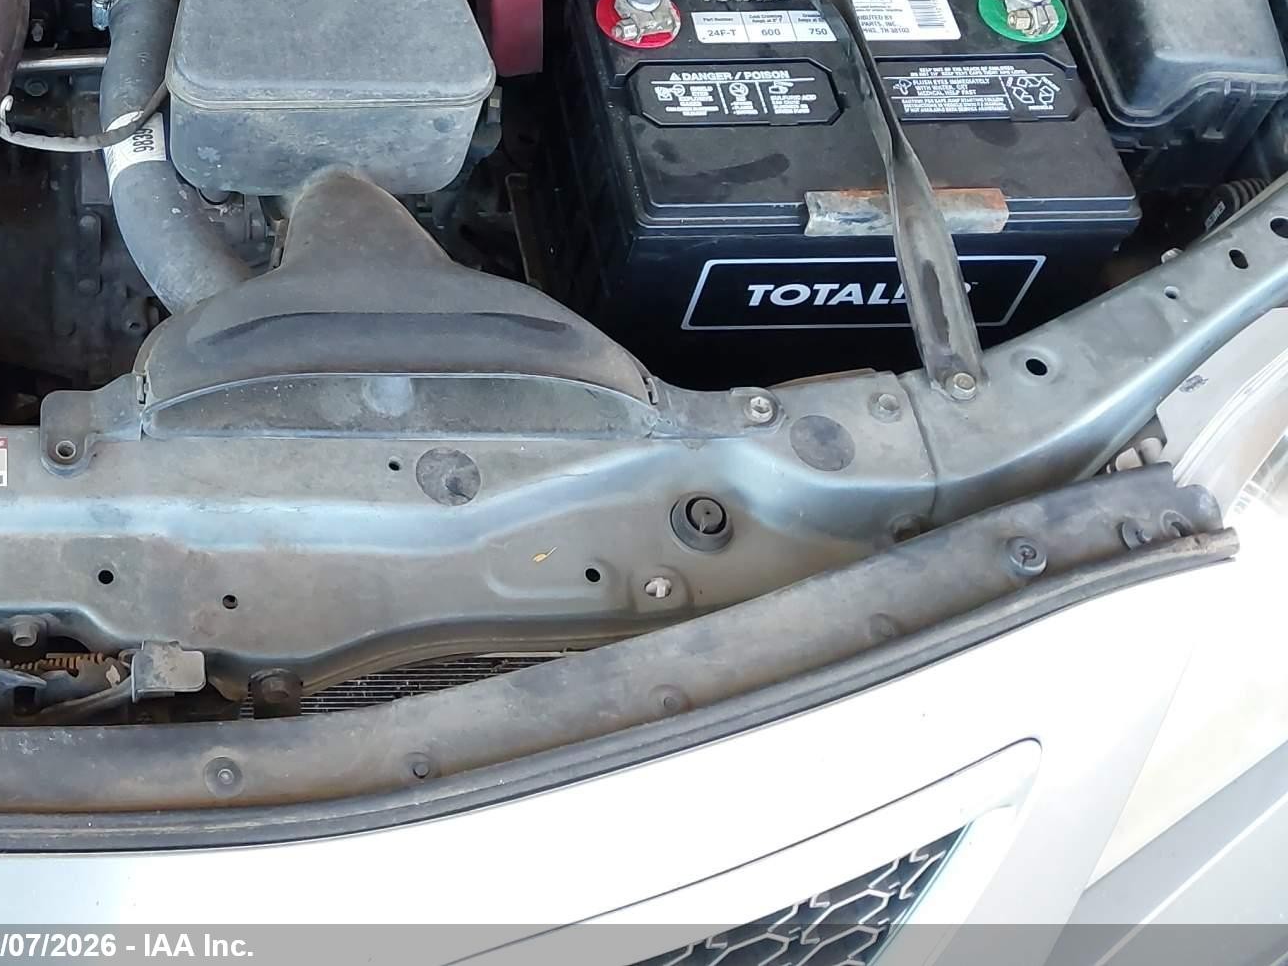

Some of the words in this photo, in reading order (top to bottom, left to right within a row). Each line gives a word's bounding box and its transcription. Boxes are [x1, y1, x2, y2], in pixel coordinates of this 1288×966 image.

[707, 29, 737, 37] 24F-T
[761, 28, 781, 36] 600
[808, 28, 828, 36] 750
[681, 72, 733, 81] DANGER
[743, 70, 791, 80] POISON
